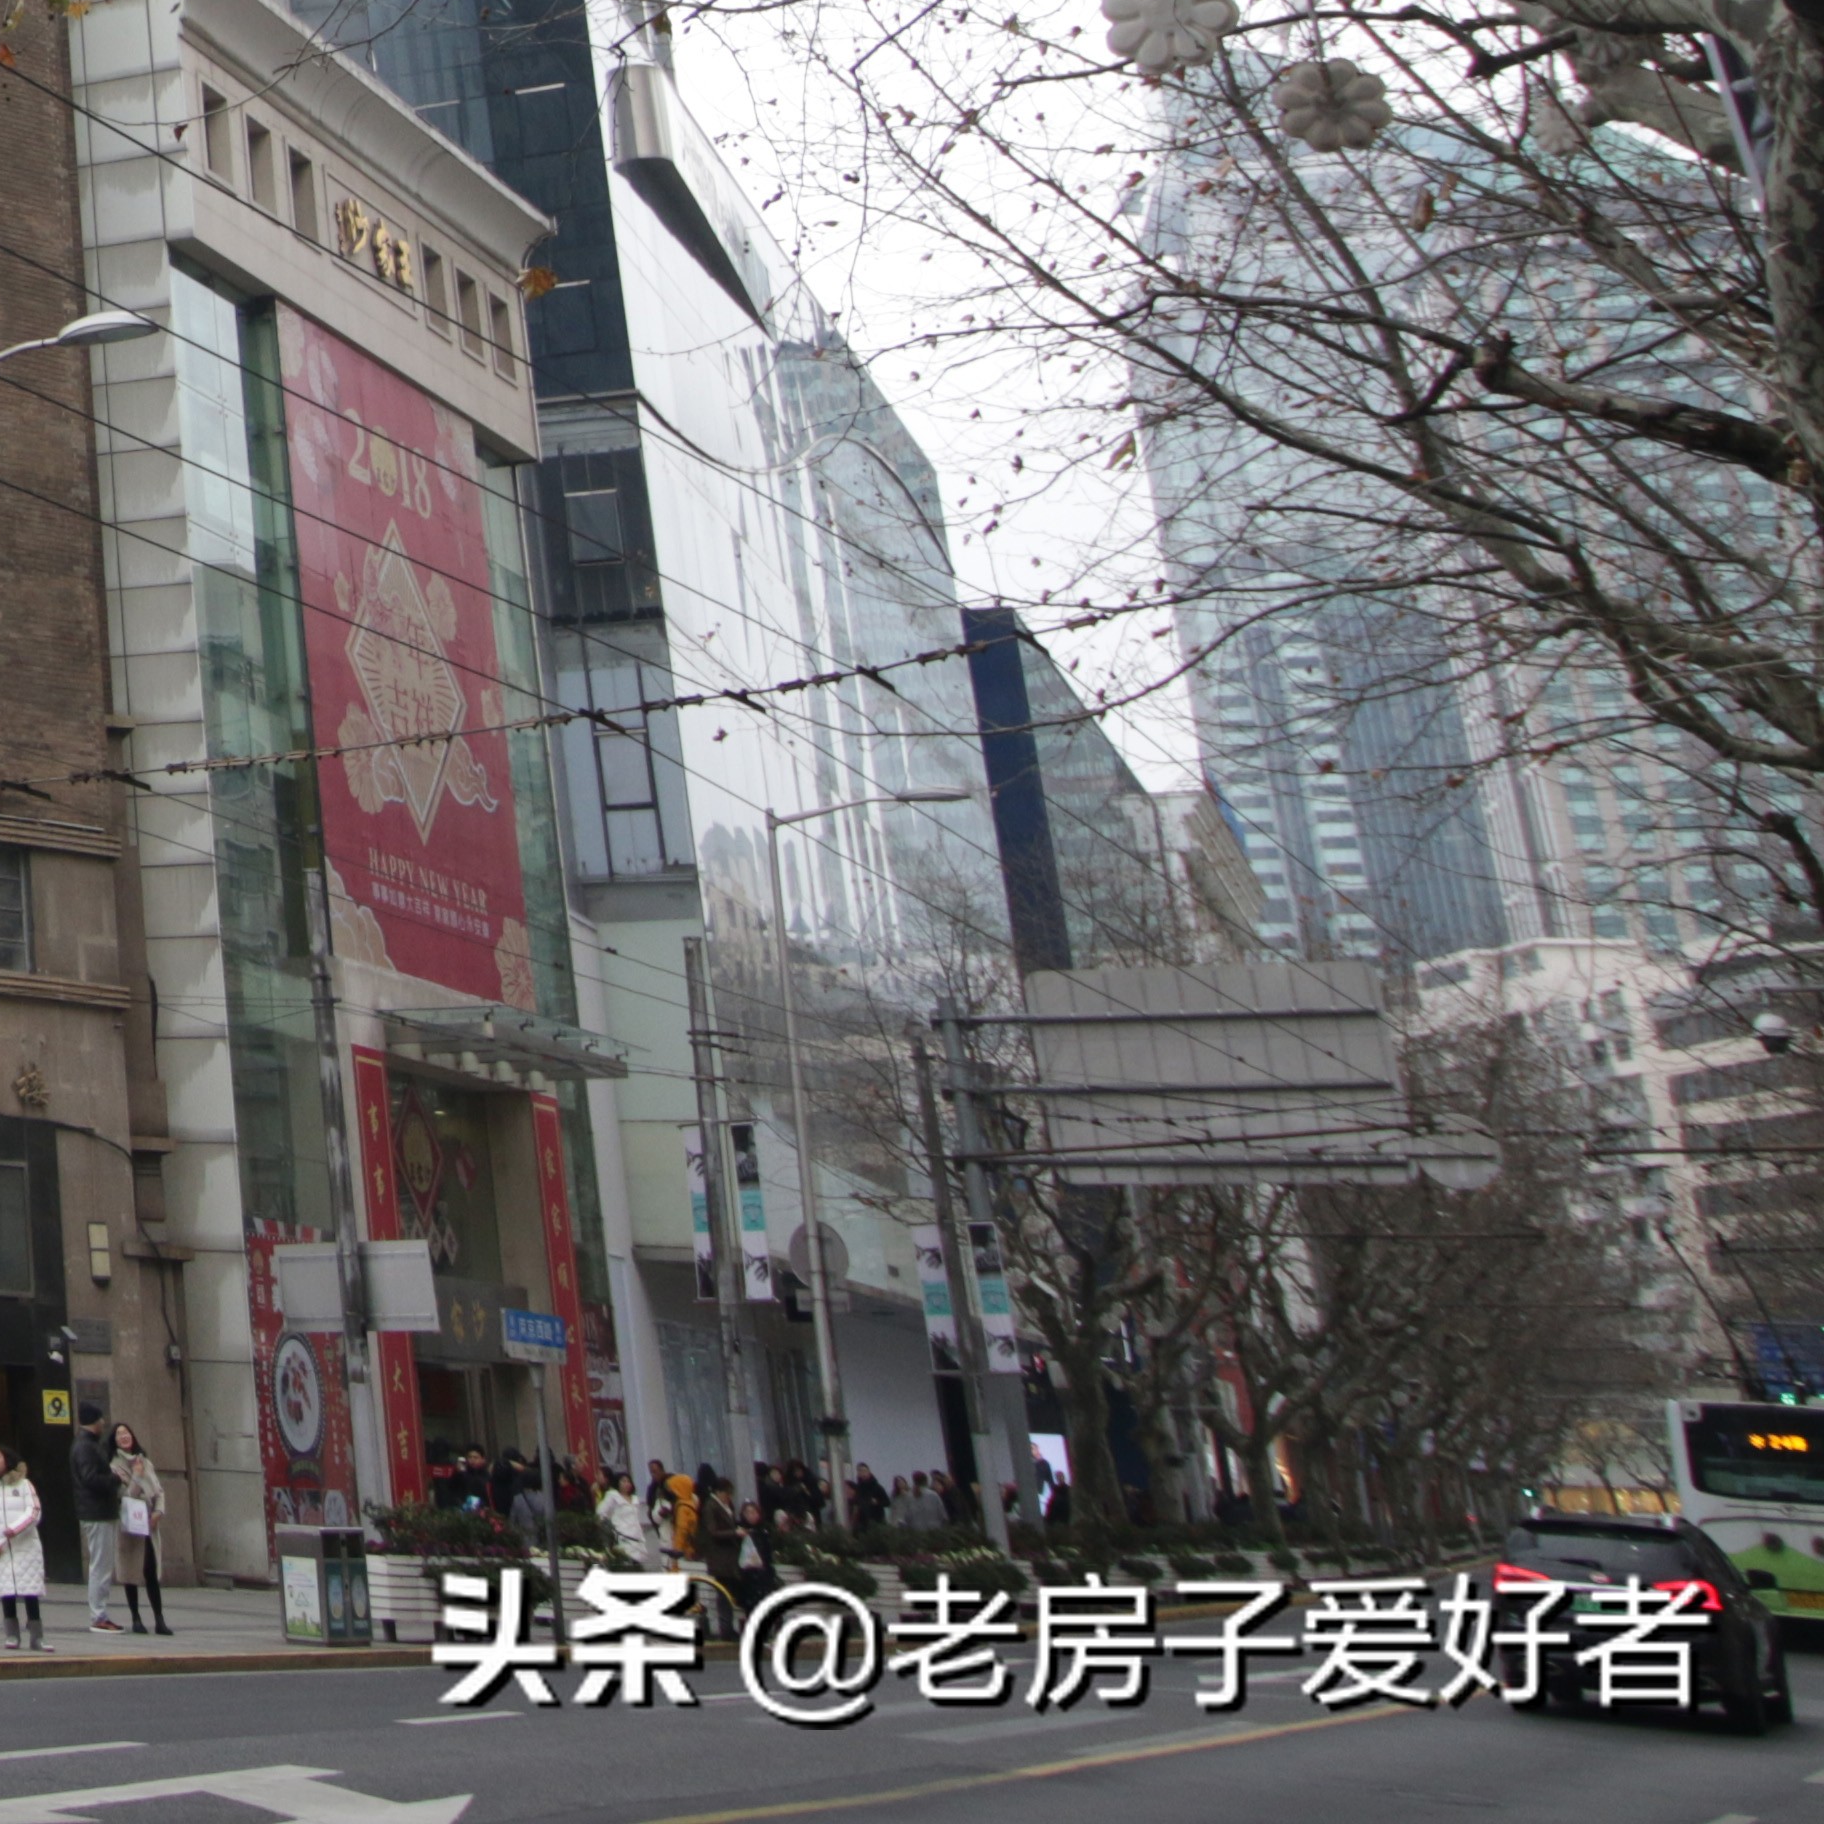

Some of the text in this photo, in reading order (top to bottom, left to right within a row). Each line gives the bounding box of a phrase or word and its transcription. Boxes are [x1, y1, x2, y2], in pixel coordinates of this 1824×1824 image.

[369, 847, 489, 916] HAPPY NEW YEAR
